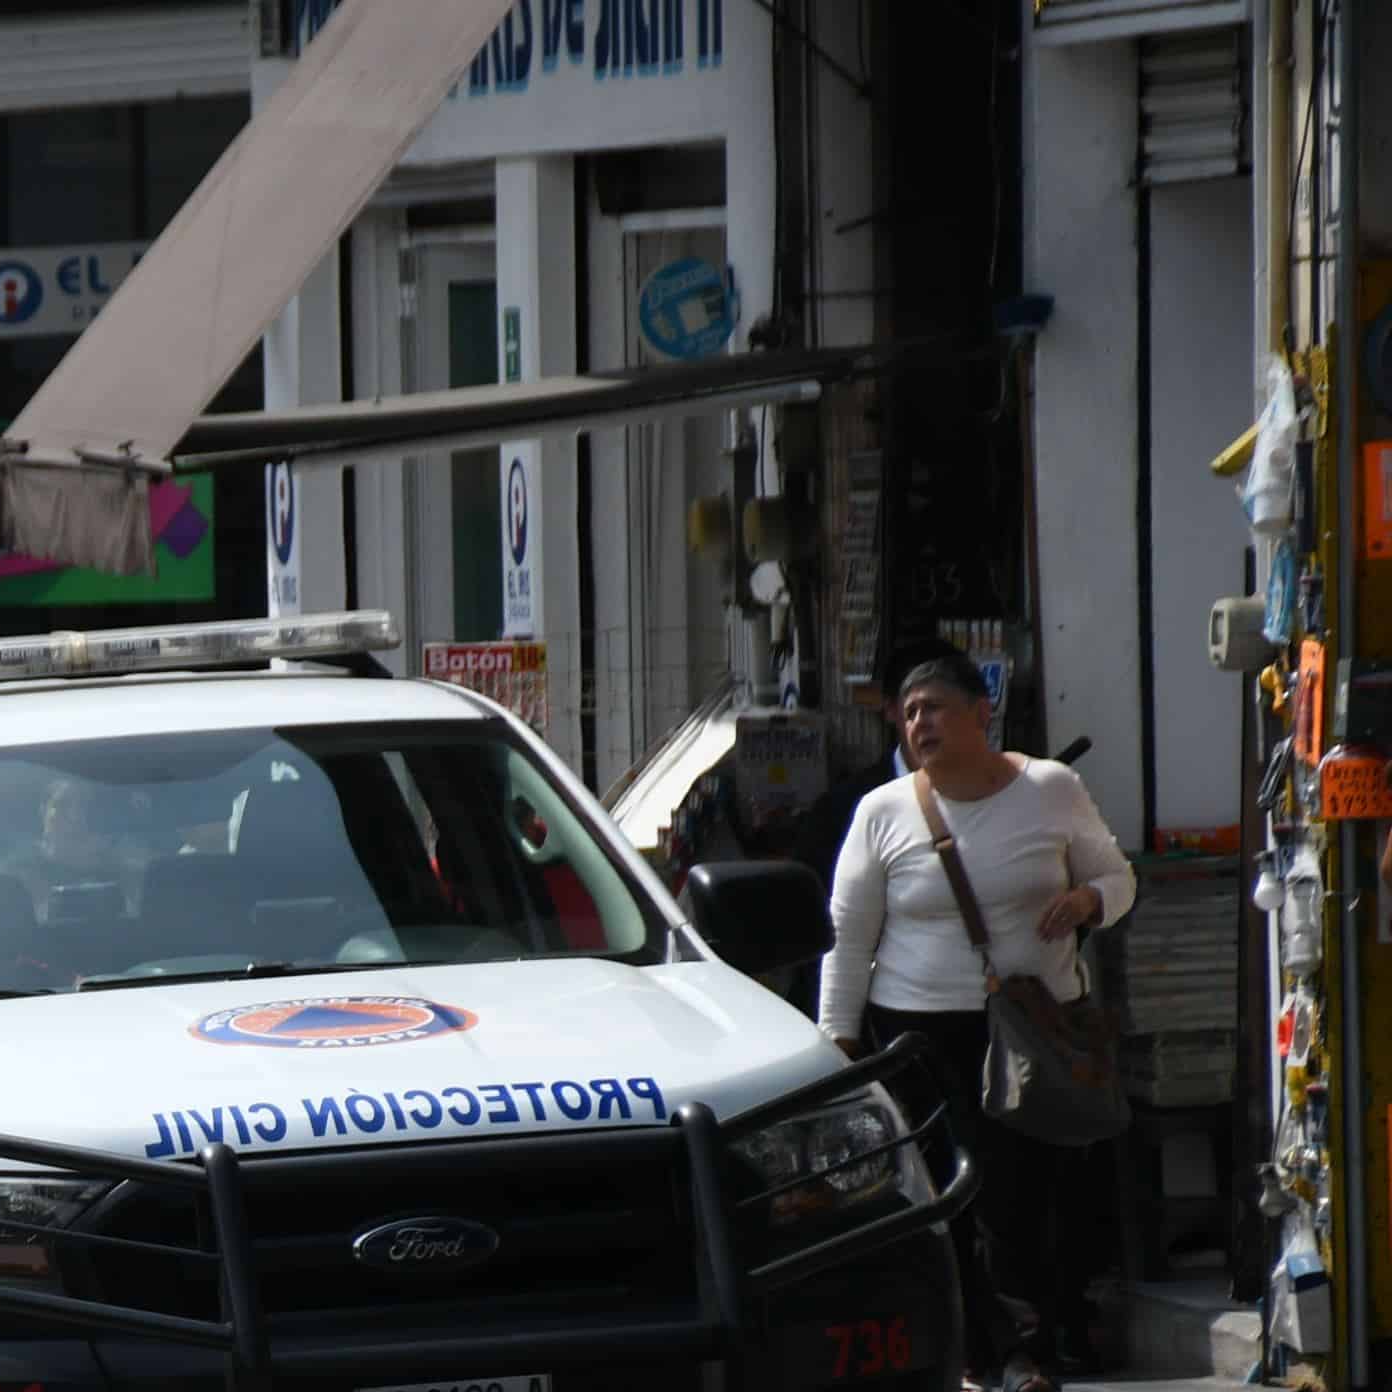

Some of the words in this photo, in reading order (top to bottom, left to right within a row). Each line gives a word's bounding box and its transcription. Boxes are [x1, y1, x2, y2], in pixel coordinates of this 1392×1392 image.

[57, 255, 111, 294] EL
[389, 1227, 466, 1261] Ford
[825, 1316, 911, 1376] 736
